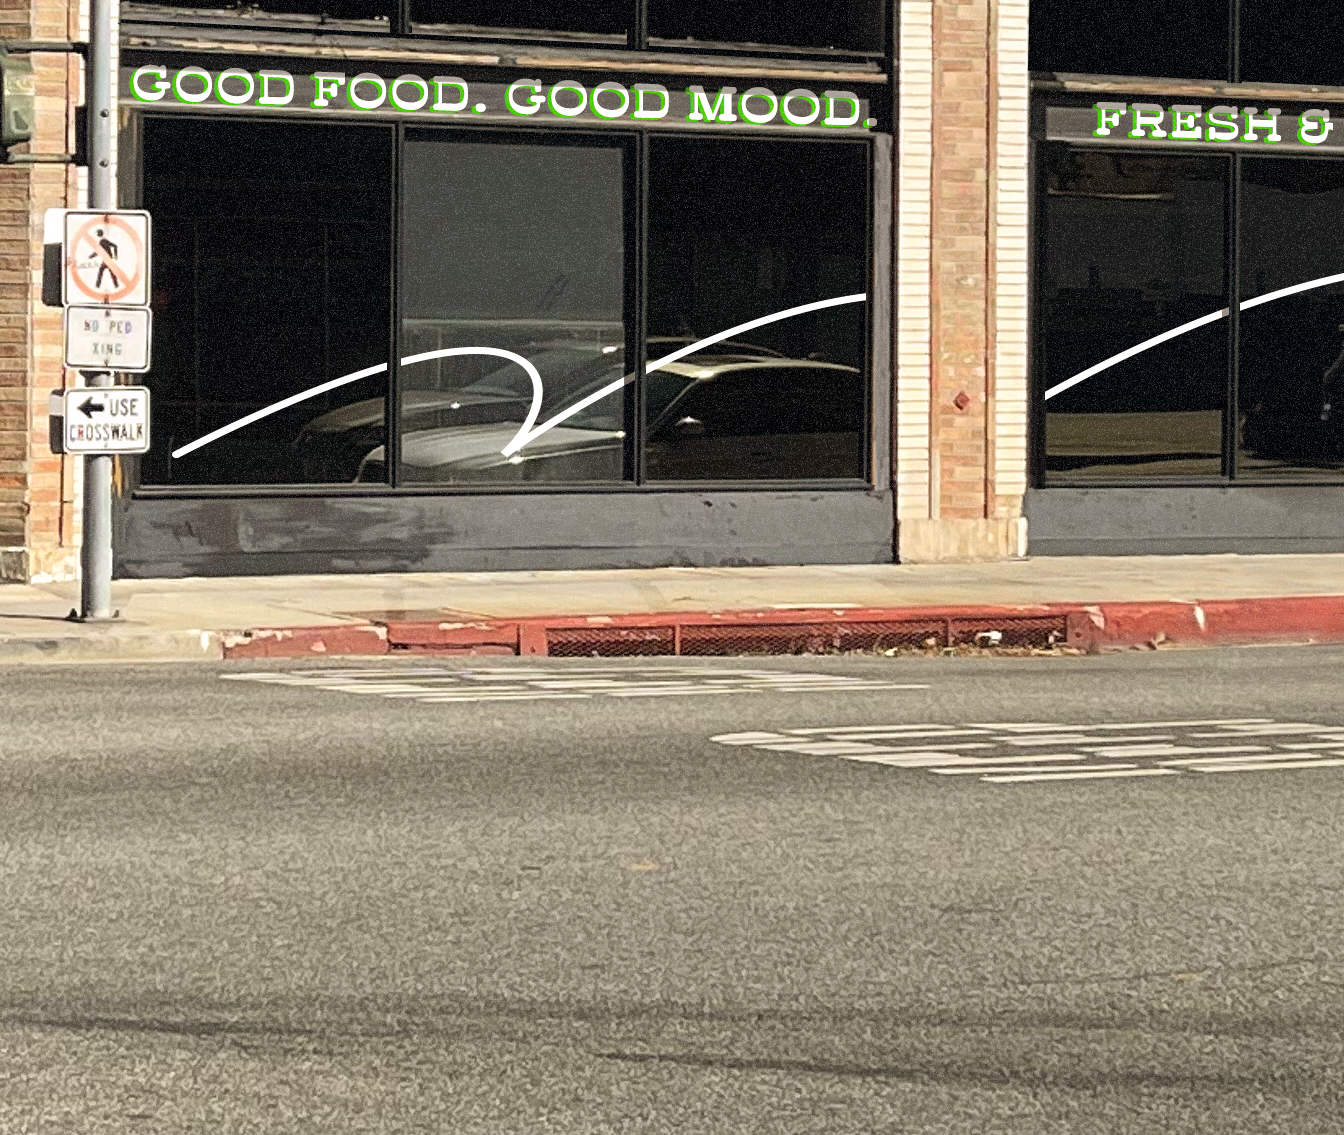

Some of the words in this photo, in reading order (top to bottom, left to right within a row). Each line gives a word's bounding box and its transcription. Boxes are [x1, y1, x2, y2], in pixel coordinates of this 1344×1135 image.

[129, 64, 295, 108] GOOD
[310, 70, 487, 114] FOOD.
[504, 77, 670, 120] GOOD
[685, 83, 878, 130] MOOD.
[1092, 101, 1282, 144] FRESH
[1296, 108, 1334, 146] &
[84, 319, 99, 333] NO
[109, 320, 132, 334] PED
[92, 342, 123, 356] XING
[109, 398, 138, 416] USE
[69, 422, 143, 442] CROSSWALK
